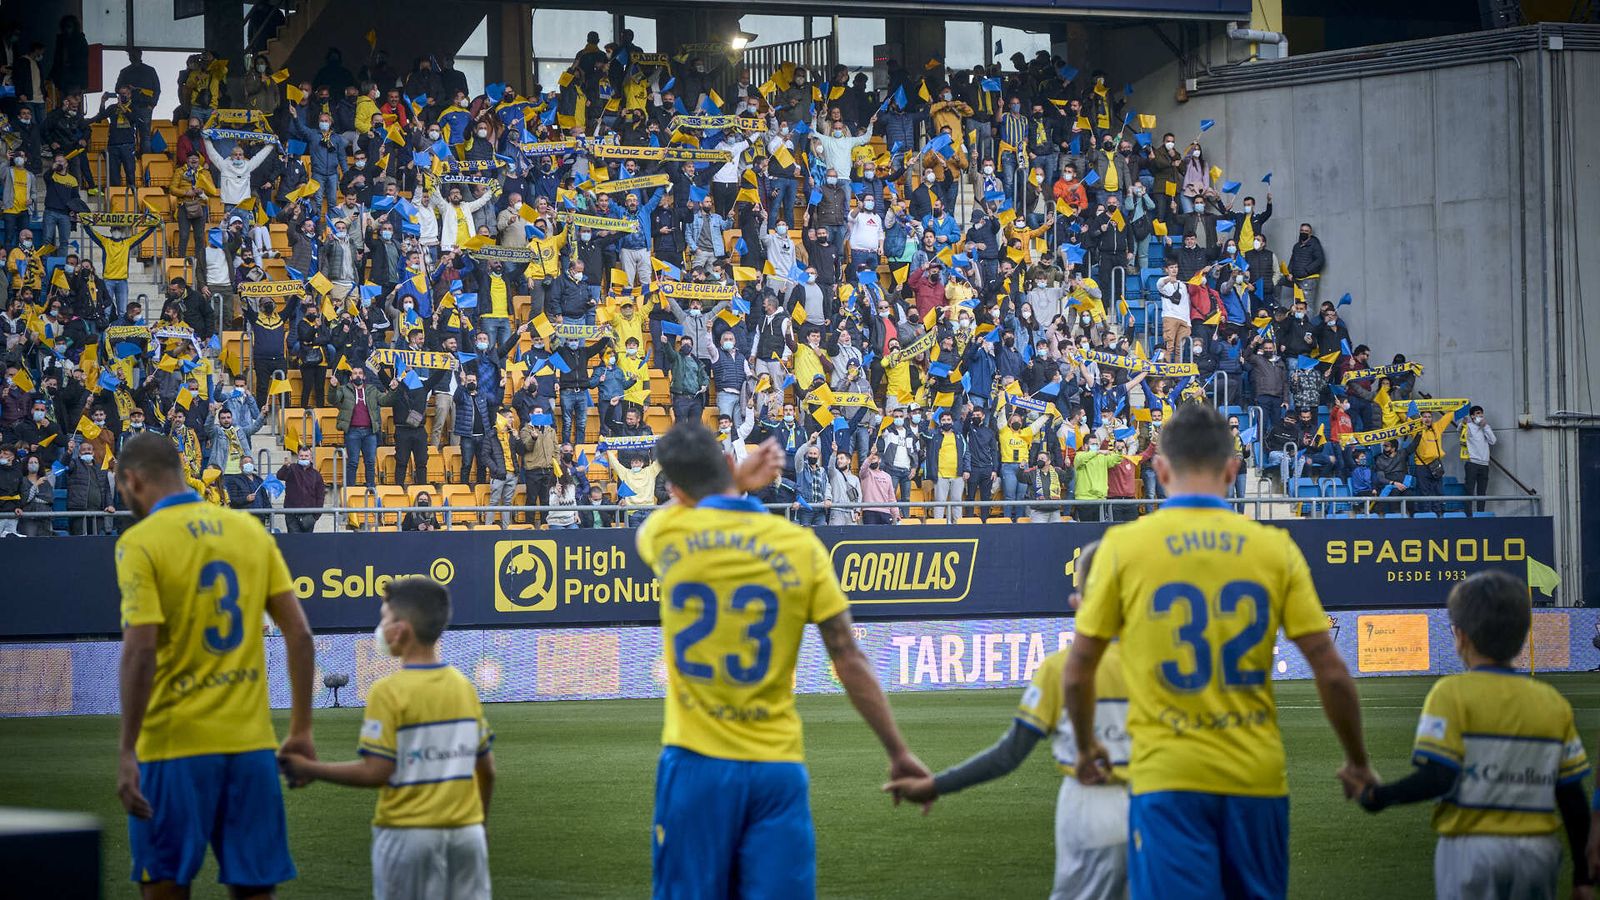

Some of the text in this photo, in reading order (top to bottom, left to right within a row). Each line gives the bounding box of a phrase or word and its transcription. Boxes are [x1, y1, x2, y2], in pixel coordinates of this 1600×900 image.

[523, 144, 553, 153] CADIZ
[444, 175, 471, 183] CADIZ
[100, 214, 125, 223] CADIZ
[676, 283, 735, 293] CHE GUEVARA
[557, 325, 584, 335] CADIZ
[901, 342, 923, 357] CADIZ
[1086, 349, 1118, 364] CADIZ
[420, 353, 438, 367] C.F.
[1364, 423, 1418, 442] CADIZ C.F.
[606, 437, 642, 446] CADIZ
[186, 519, 224, 540] FALI
[1165, 530, 1248, 556] CHUST
[1326, 537, 1526, 564] SPAGNOLO
[564, 545, 626, 576] High
[841, 551, 961, 593] GORILLAS
[1387, 570, 1467, 582] DESDE 1933
[200, 559, 245, 656] 3
[670, 581, 779, 687] 23
[1150, 579, 1271, 694] 32
[892, 633, 1046, 686] TARJETA
